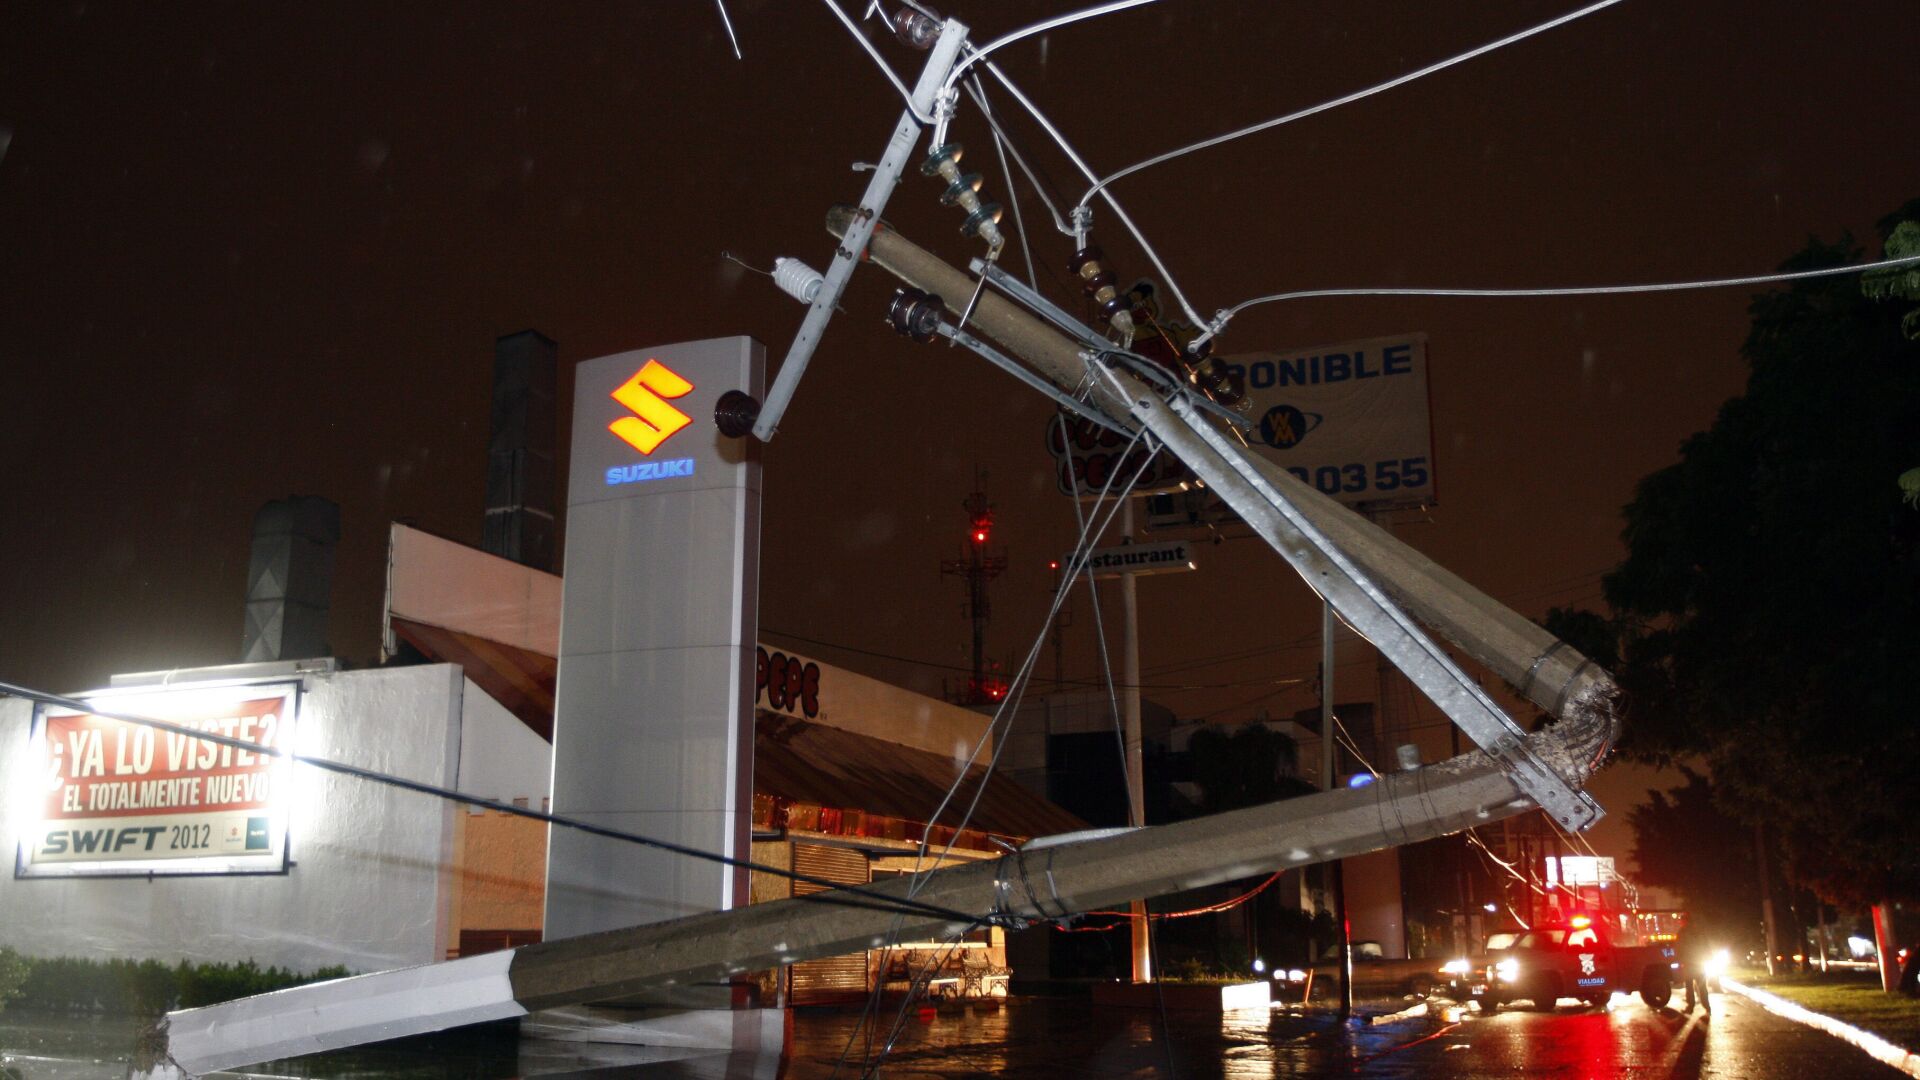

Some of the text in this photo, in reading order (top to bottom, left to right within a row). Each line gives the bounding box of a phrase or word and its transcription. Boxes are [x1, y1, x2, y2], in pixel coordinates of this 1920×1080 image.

[606, 458, 694, 486] SUZUKI
[48, 713, 277, 792] ¿YA LO VISTE?
[63, 772, 271, 813] EL TOTALMENTE NUEVO
[41, 823, 211, 855] SWIFT 2012
